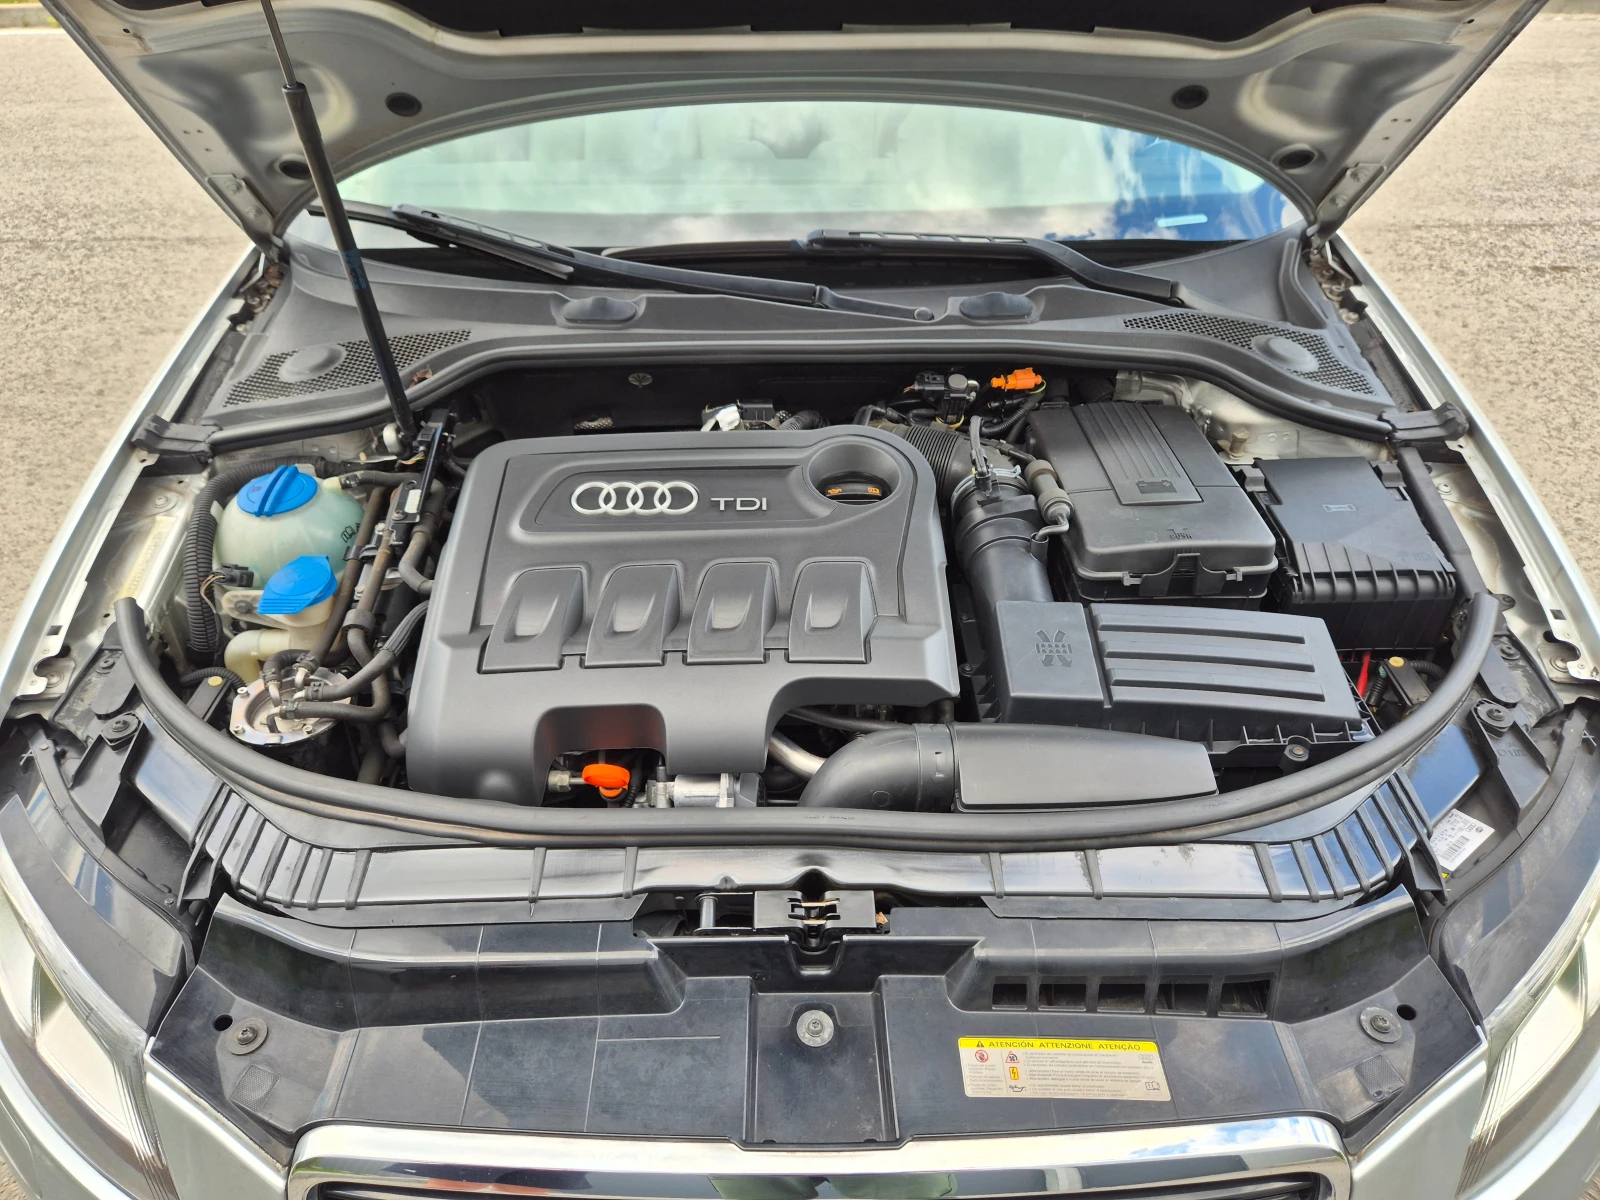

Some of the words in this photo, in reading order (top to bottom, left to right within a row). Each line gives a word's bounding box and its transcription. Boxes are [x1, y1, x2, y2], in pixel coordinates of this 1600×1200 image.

[711, 497, 767, 511] TDI
[988, 1040, 1034, 1048] ATENCIÓN
[1039, 1041, 1094, 1049] ATTENZIONE
[1098, 1042, 1141, 1051] ATENÇÃO
